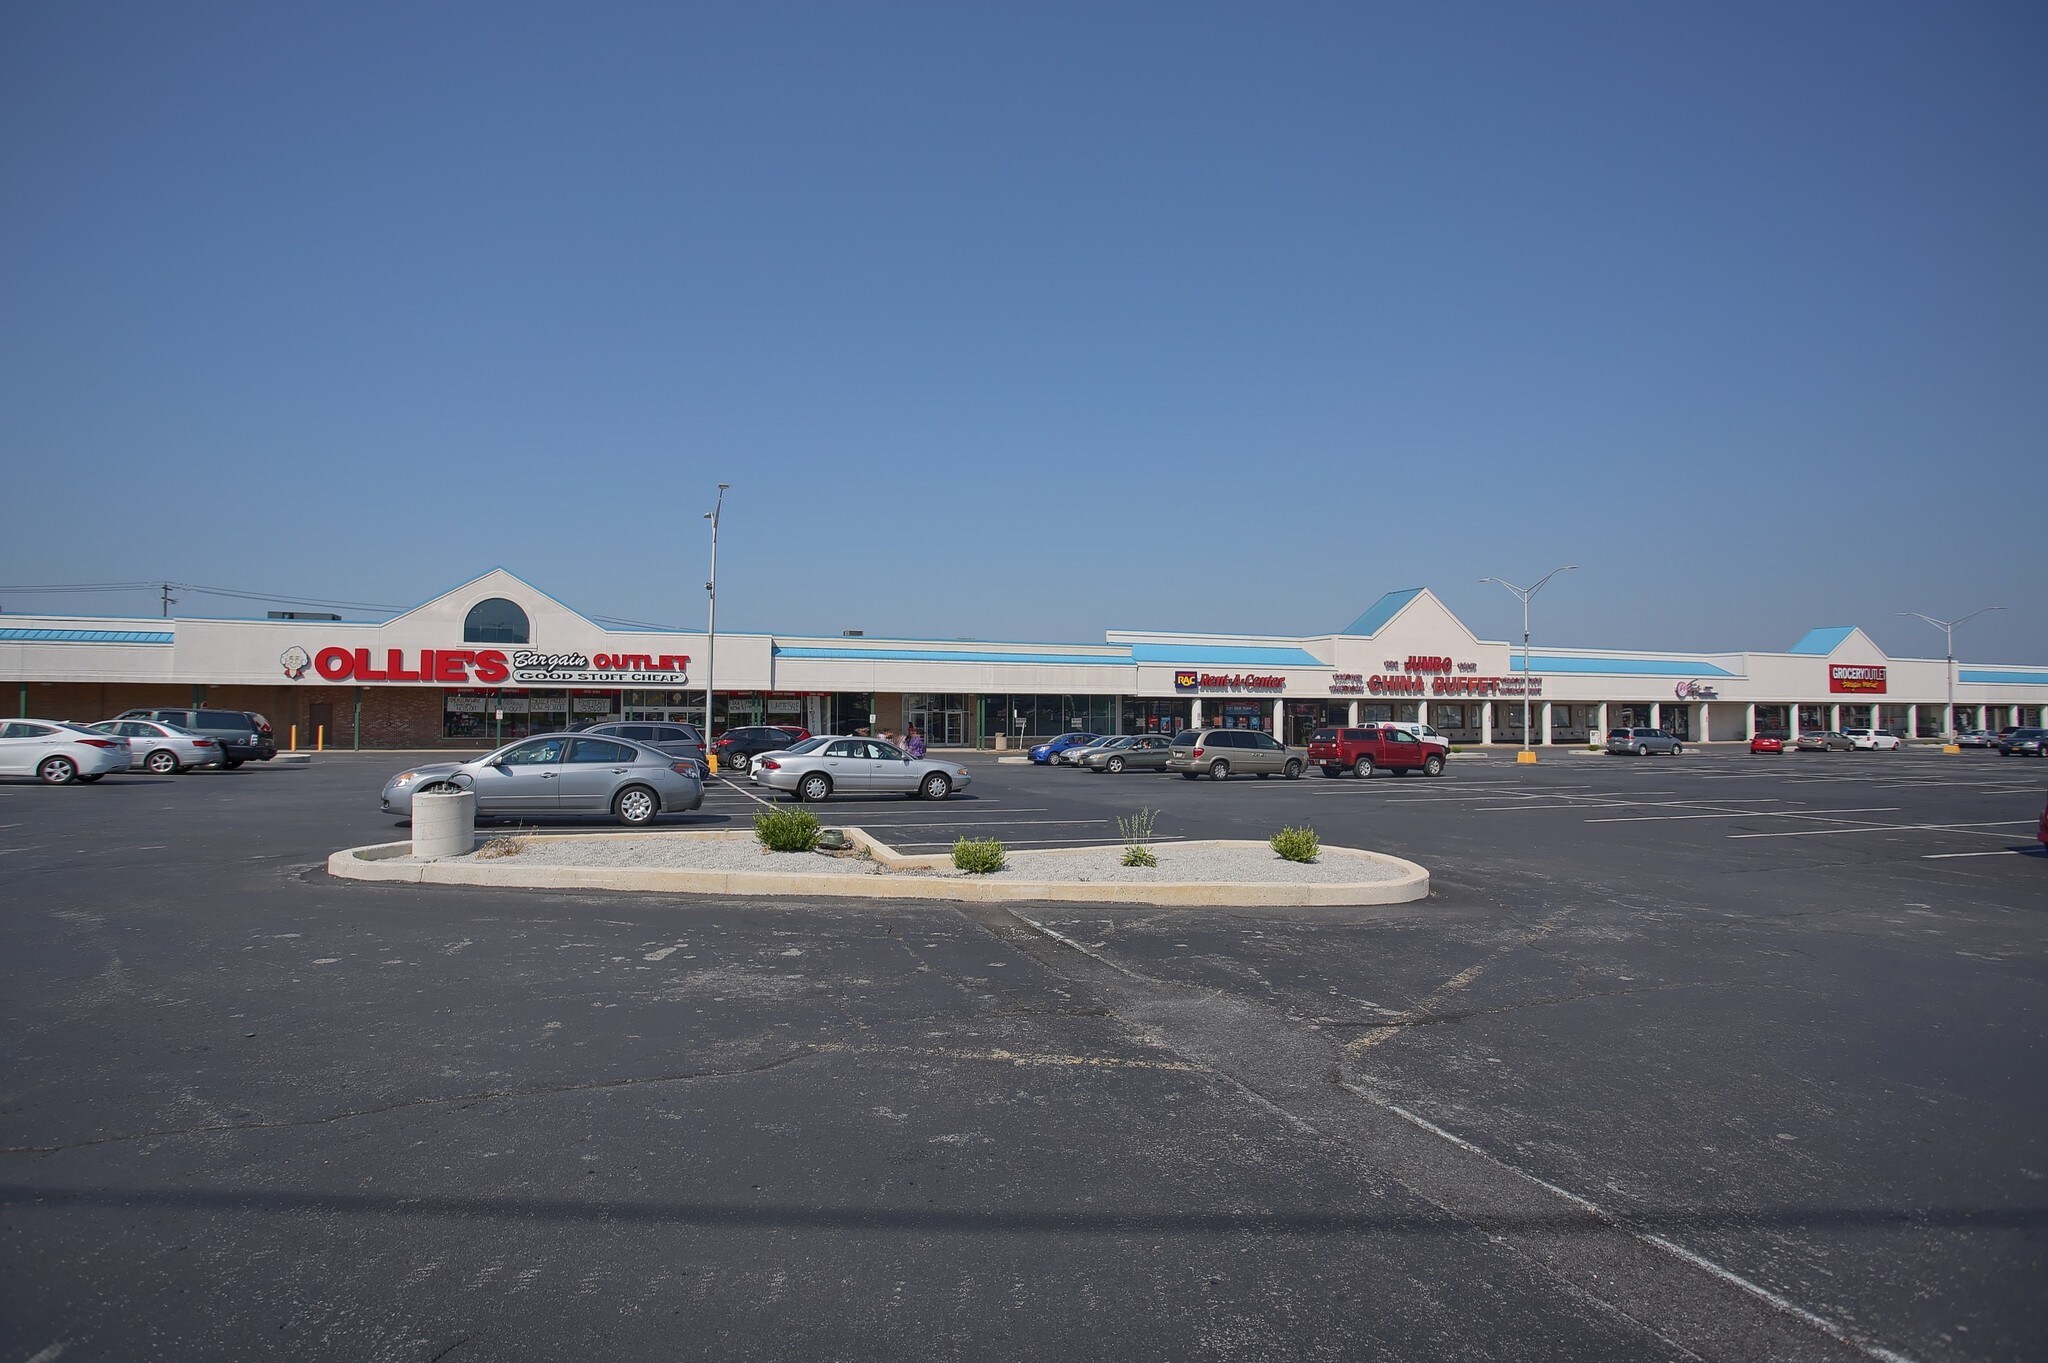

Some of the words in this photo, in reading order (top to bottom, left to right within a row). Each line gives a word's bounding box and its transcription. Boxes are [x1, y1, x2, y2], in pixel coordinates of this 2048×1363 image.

[314, 646, 509, 682] OLLIE'S
[514, 651, 587, 672] Bargain
[593, 654, 689, 670] OUTLET
[1404, 656, 1453, 673] JUMBO
[578, 673, 627, 681] STUFF
[1177, 676, 1196, 686] RAC
[1368, 674, 1425, 692] CHINA
[1433, 676, 1500, 693] BUFFET
